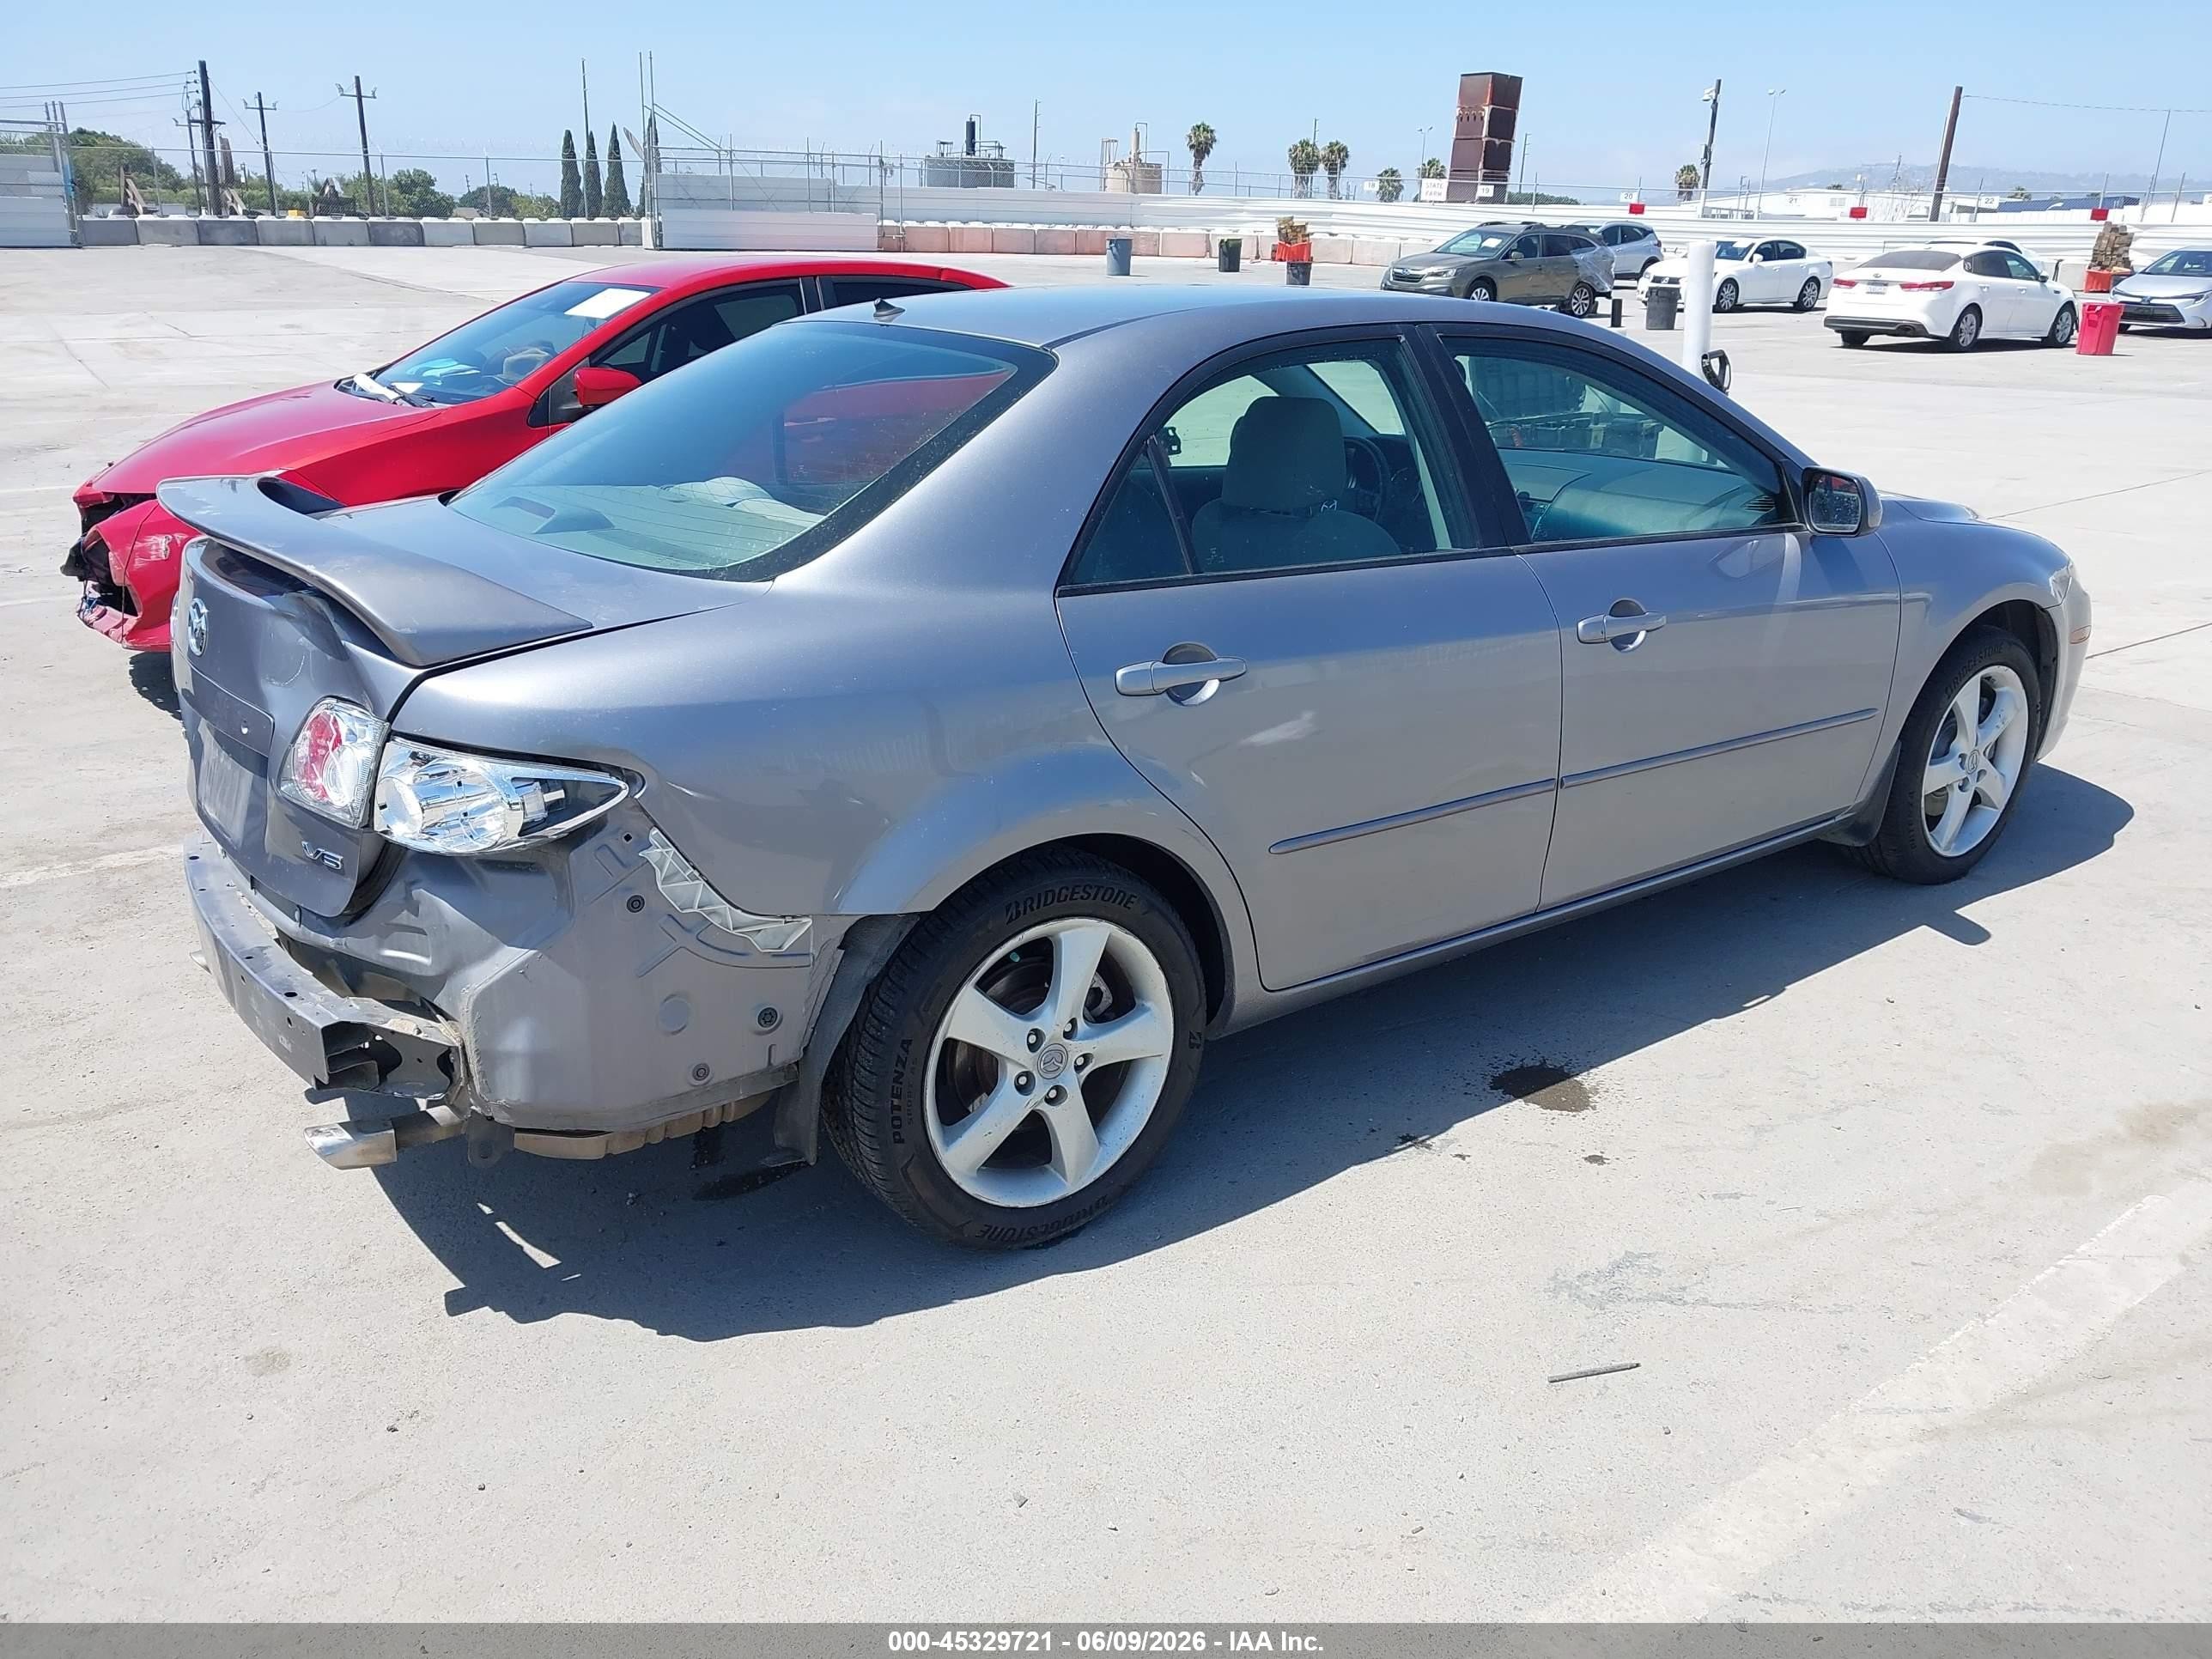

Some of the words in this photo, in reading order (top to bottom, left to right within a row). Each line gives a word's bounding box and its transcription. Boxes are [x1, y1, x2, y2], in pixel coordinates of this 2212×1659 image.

[301, 841, 343, 870] V6
[1005, 884, 1137, 925] BRIDGESTONE
[890, 1039, 914, 1144] POTENZA
